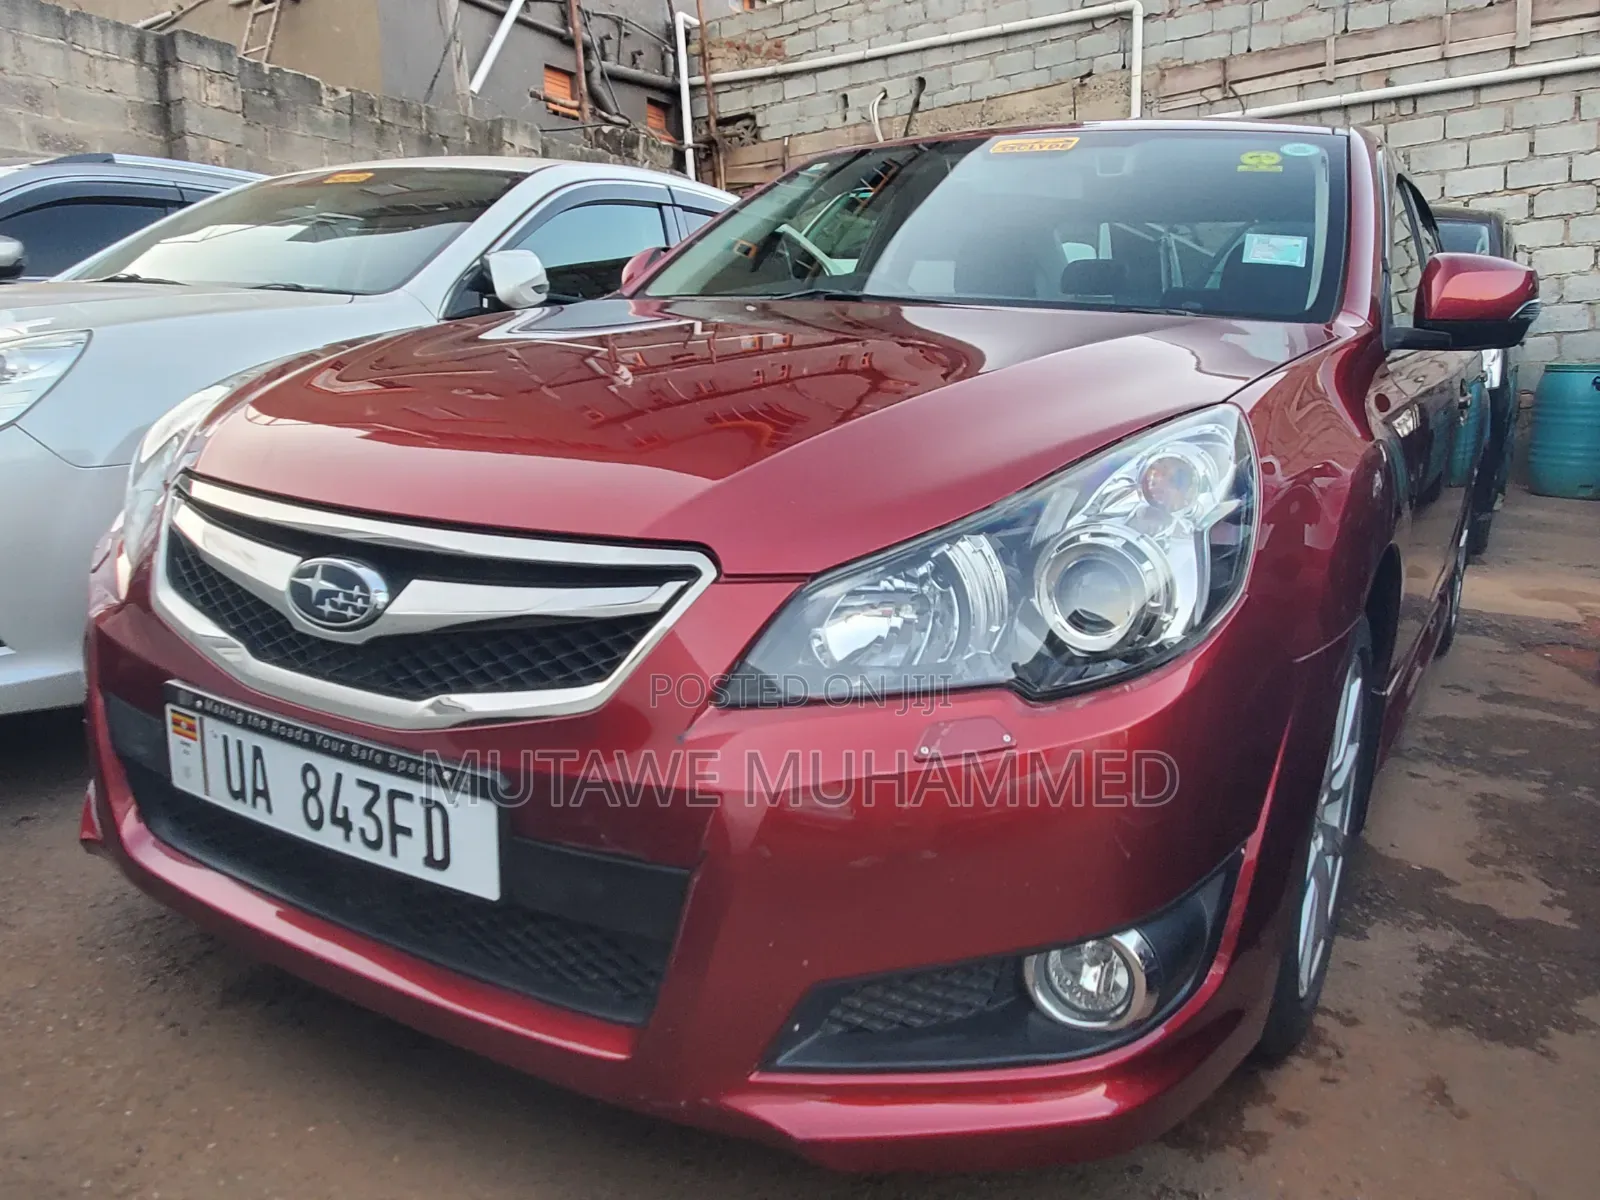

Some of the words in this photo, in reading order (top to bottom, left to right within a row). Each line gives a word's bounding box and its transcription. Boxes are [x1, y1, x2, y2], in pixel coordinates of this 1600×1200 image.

[204, 699, 244, 724] Making
[247, 714, 268, 730] the
[271, 721, 310, 742] Roads
[315, 733, 346, 753] Your
[351, 744, 382, 764] Safe
[388, 755, 437, 778] Space
[222, 733, 273, 815] UA
[301, 762, 452, 871] 843FD
